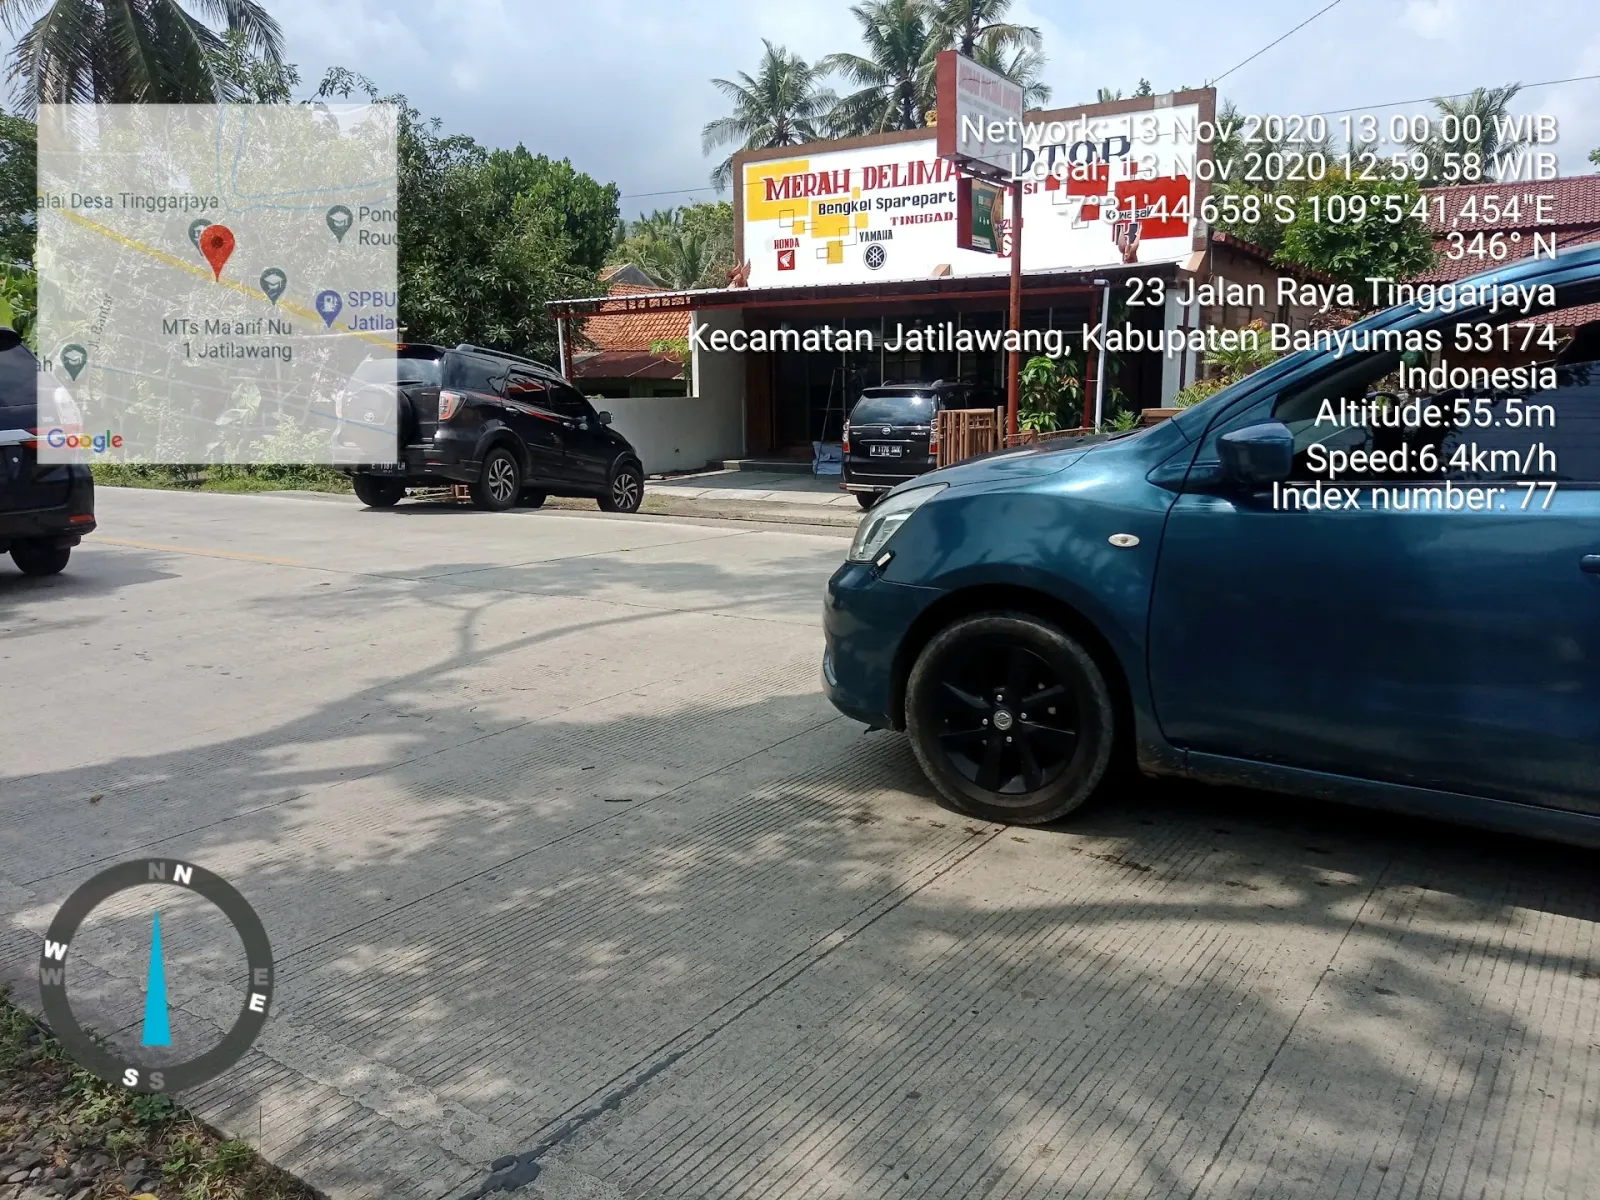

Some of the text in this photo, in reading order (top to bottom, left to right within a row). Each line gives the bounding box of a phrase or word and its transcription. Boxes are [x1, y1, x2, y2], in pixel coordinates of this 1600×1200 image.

[763, 135, 1131, 201] MERAH DELIMA OTOR
[818, 190, 956, 216] Bengkel Sparepart
[890, 211, 958, 226] TINGGAD
[773, 237, 800, 250] HONDA
[859, 229, 893, 243] YAMAHA
